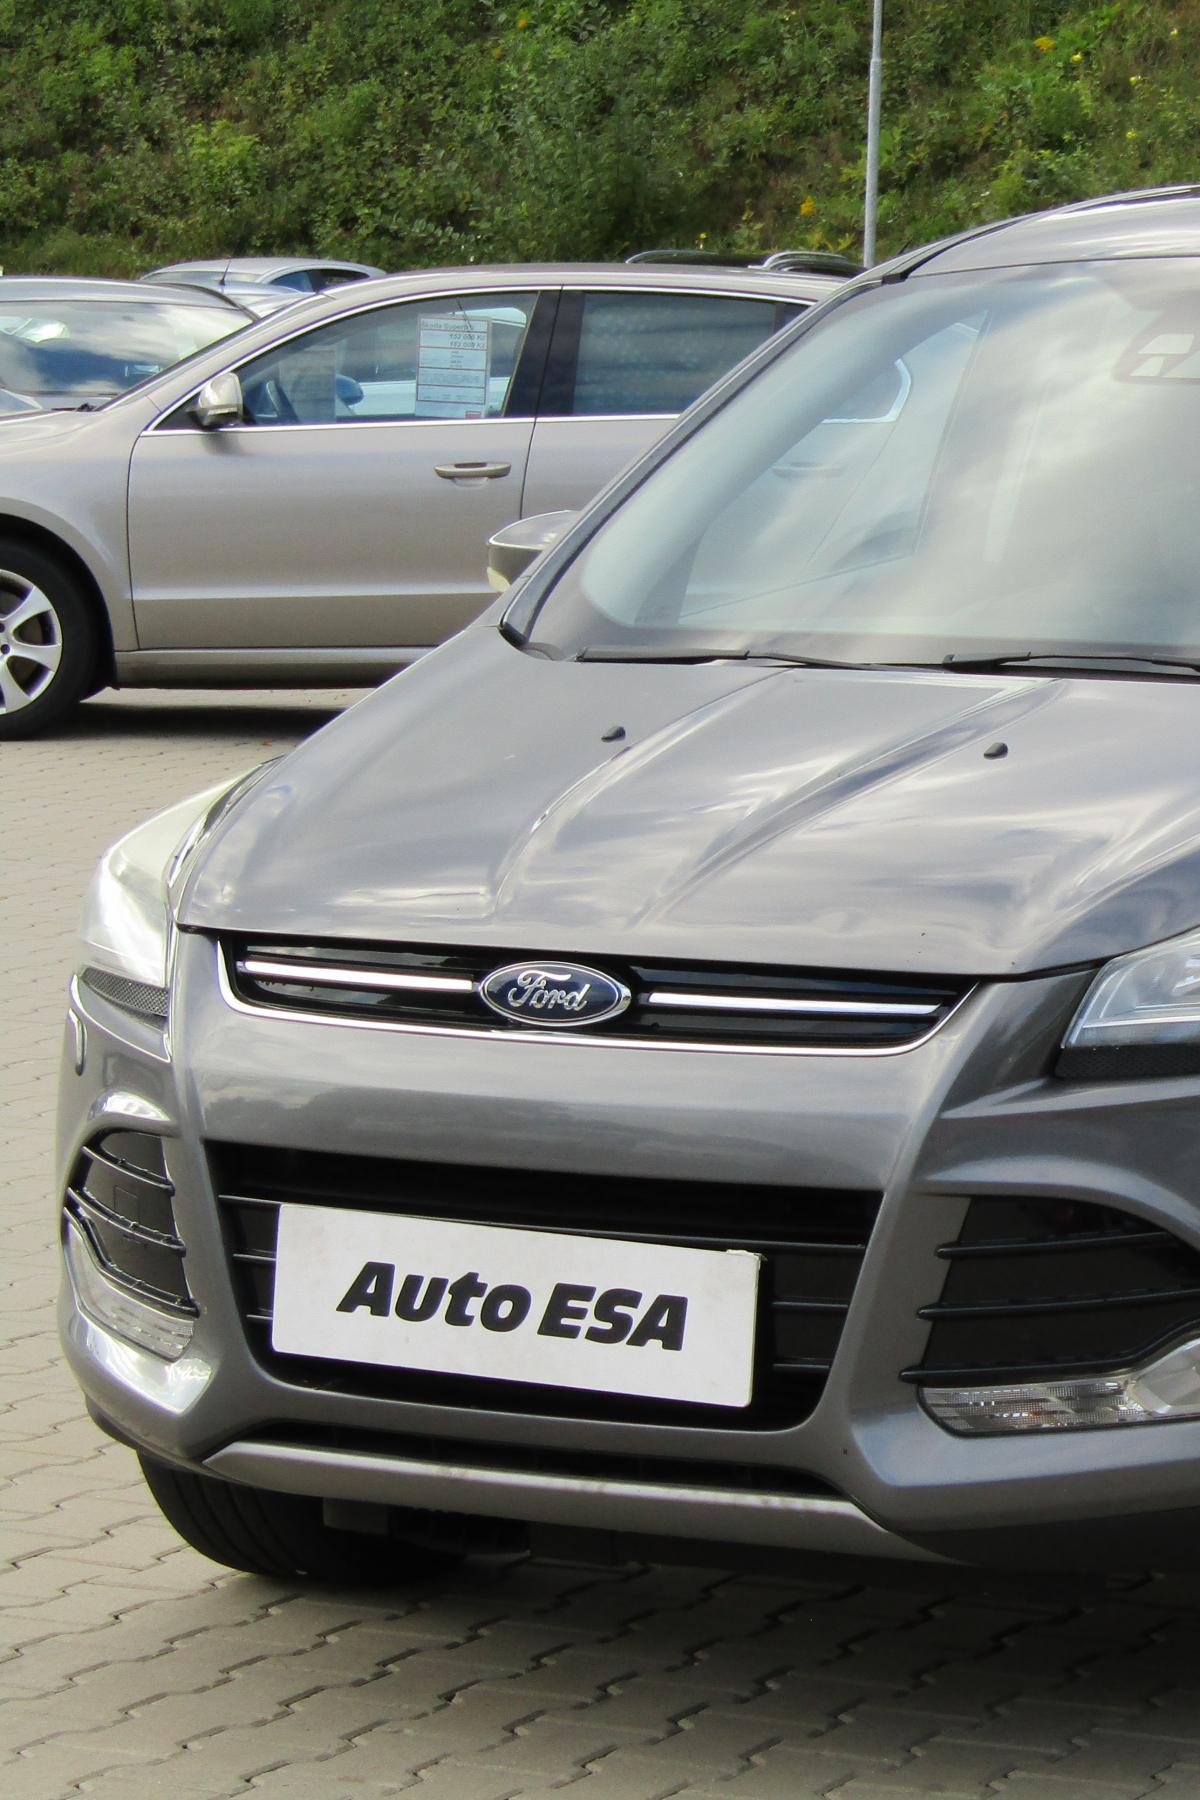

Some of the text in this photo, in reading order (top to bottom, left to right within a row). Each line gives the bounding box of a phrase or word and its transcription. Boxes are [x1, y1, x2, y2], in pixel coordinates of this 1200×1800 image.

[508, 970, 585, 1010] Ford
[336, 1261, 688, 1351] Auto ESA
